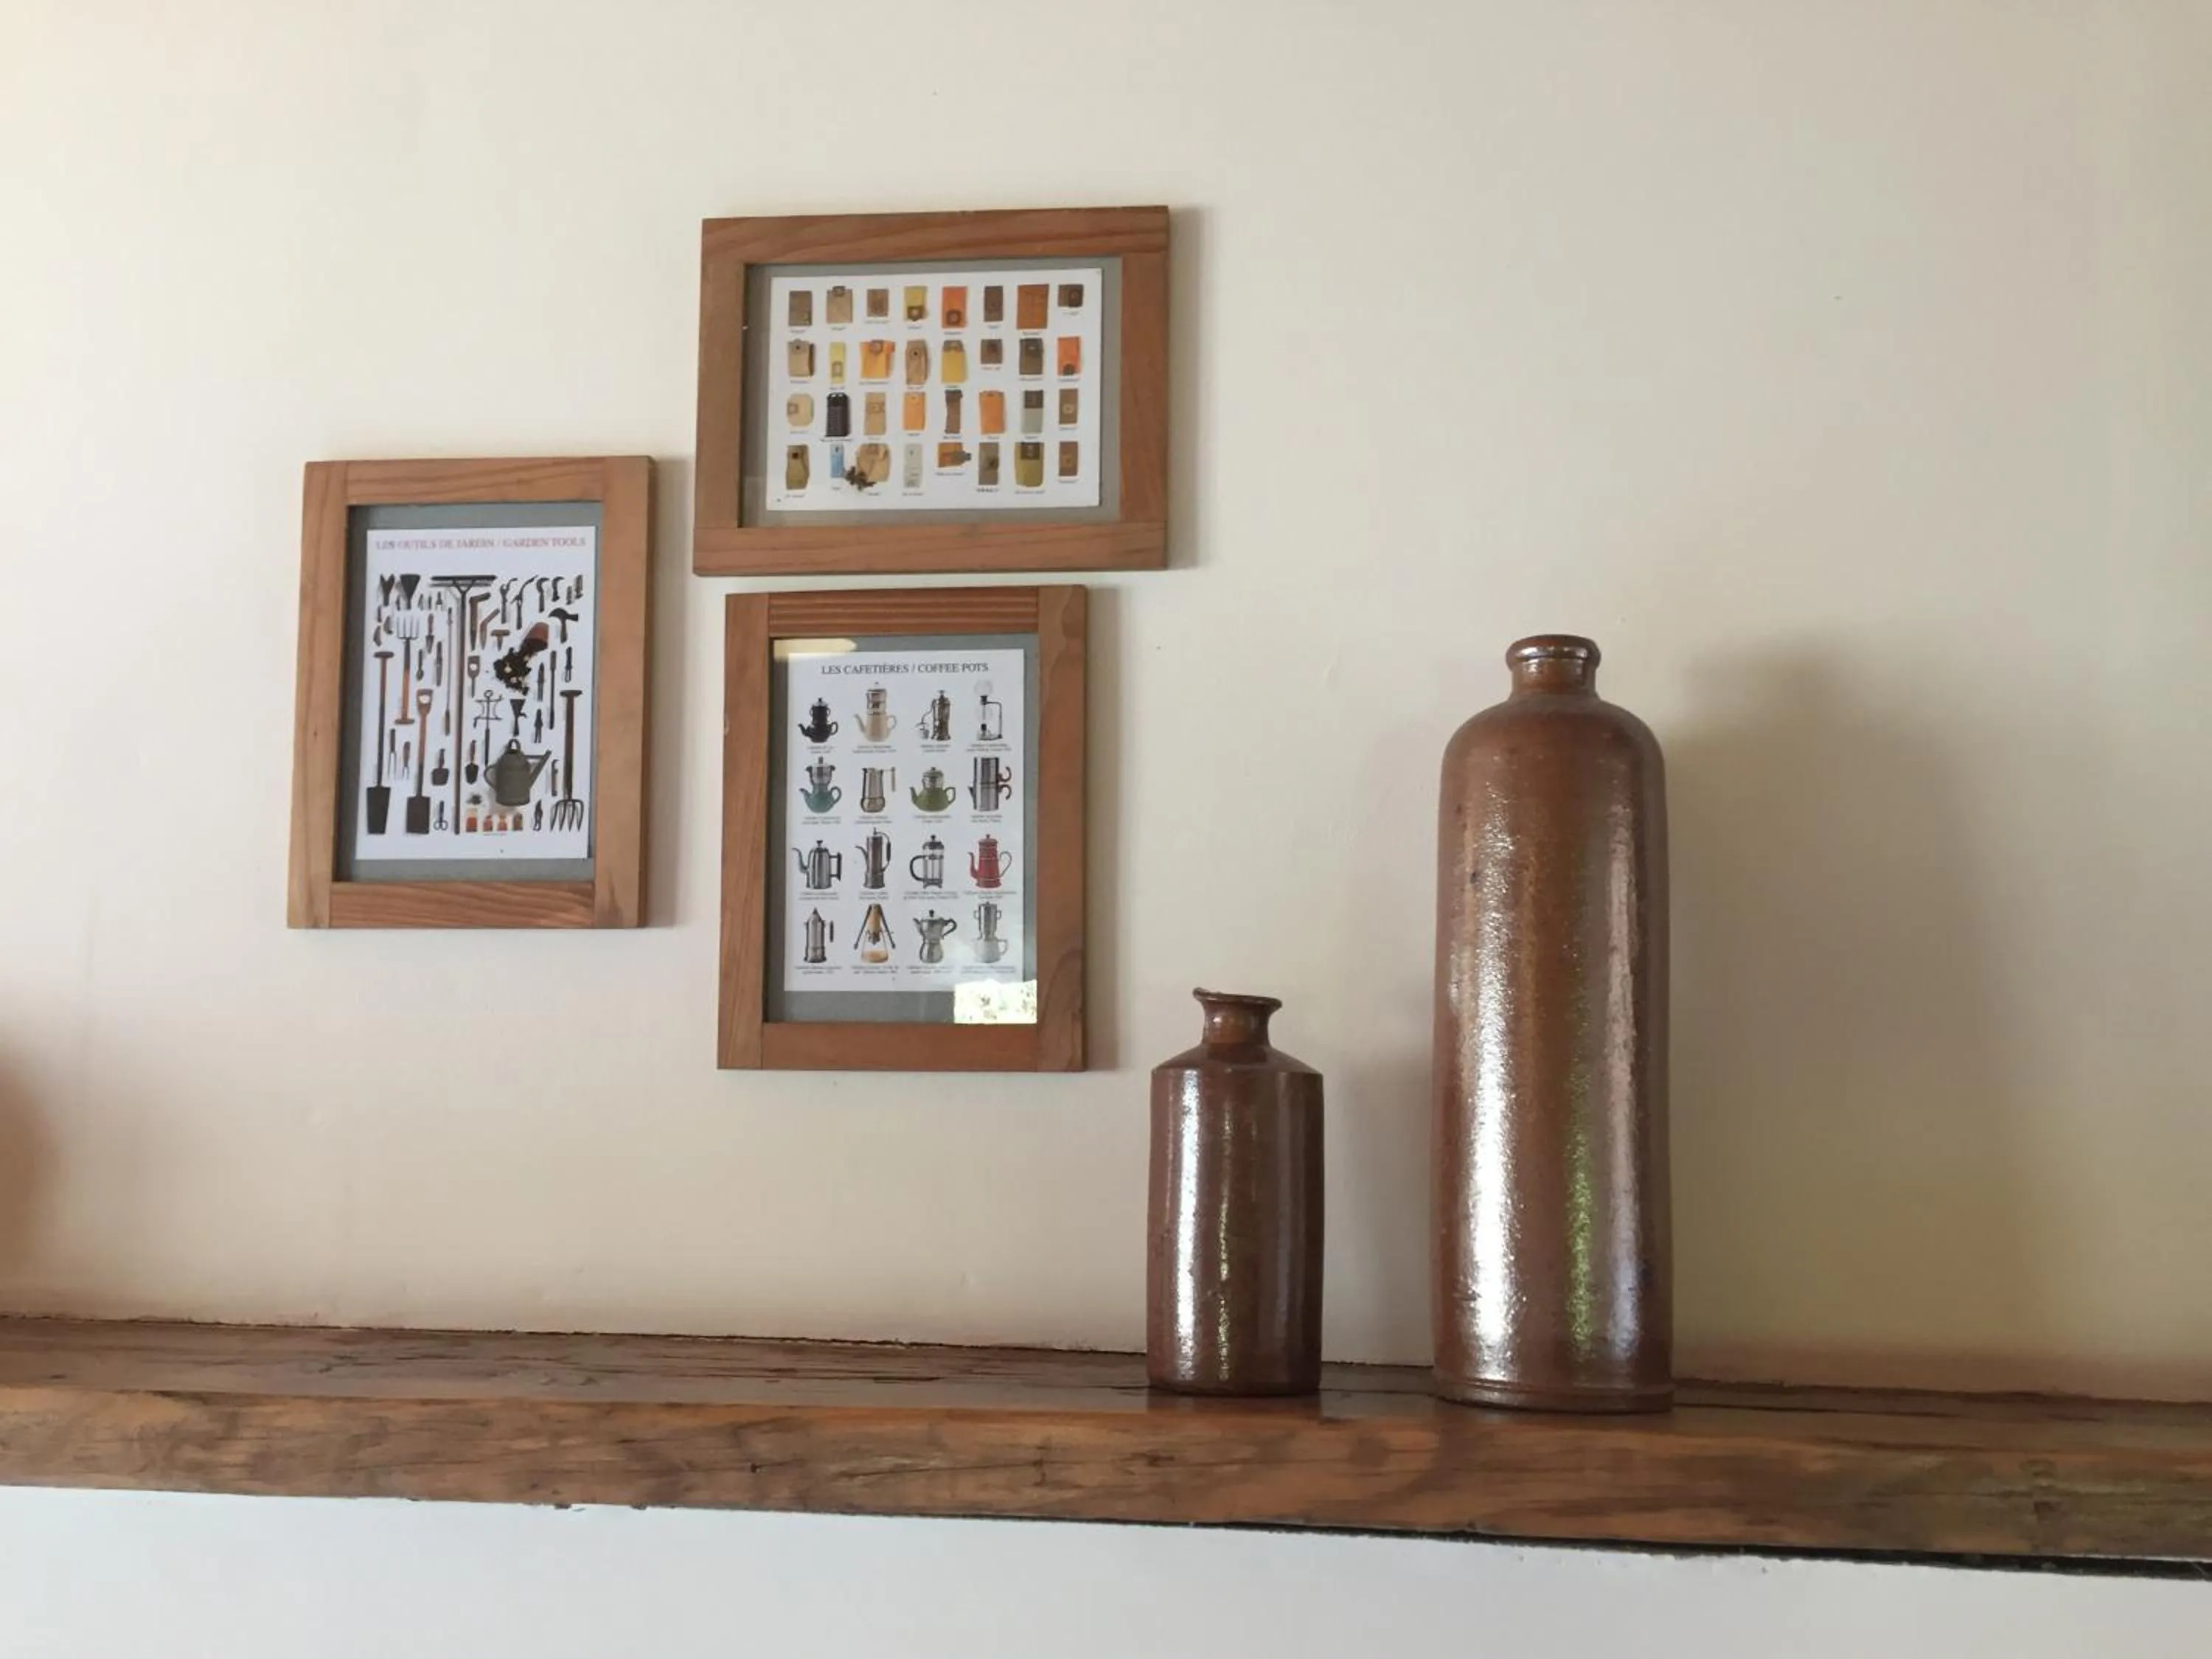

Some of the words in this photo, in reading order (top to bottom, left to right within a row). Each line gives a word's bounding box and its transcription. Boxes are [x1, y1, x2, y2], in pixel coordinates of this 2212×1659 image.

[502, 537, 549, 548] GARDEN
[552, 536, 587, 547] TOOLS
[821, 664, 842, 674] LES
[844, 662, 909, 674] CAFETIÈRES
[917, 663, 959, 673] COFFEE
[961, 662, 990, 672] POTS
